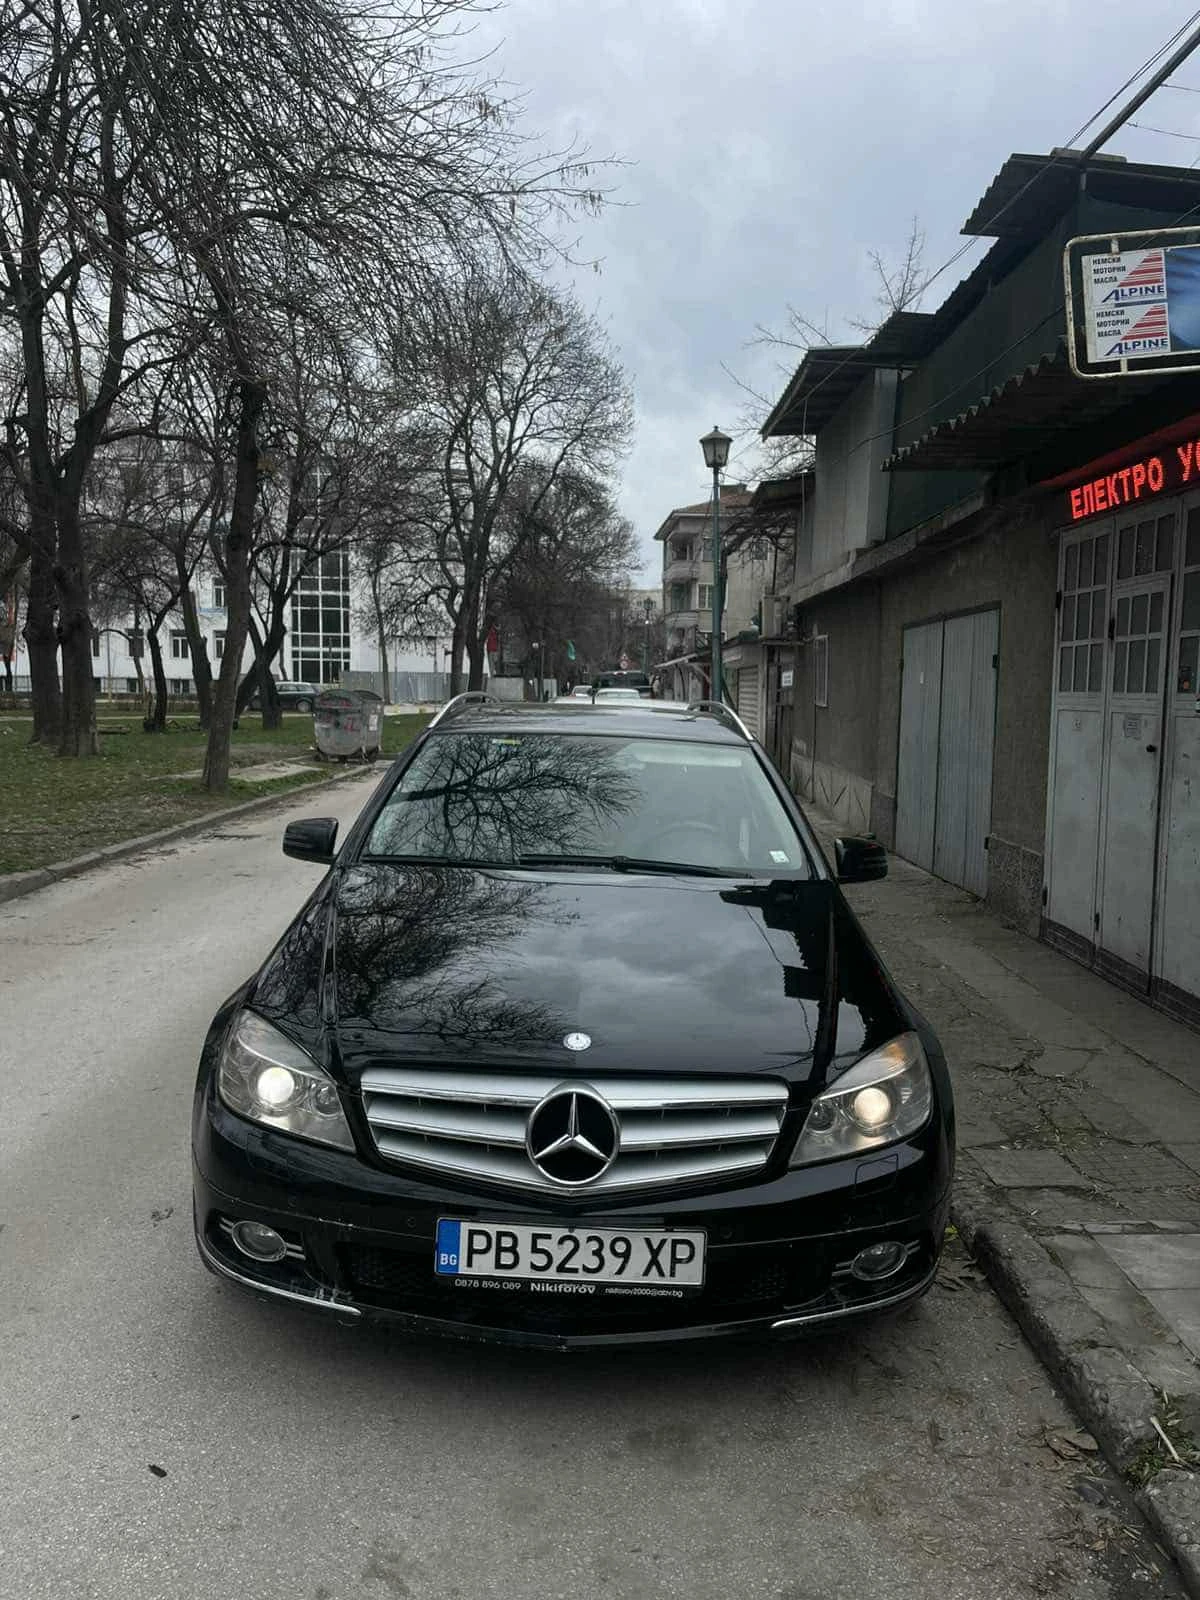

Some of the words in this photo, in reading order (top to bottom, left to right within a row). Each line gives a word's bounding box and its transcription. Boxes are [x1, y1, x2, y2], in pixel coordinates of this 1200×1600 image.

[1092, 256, 1121, 265] НЕМСКИ
[1093, 265, 1126, 275] МОТОРНИ
[1093, 276, 1118, 285] МАСЛА
[1101, 284, 1165, 303] ALPINE
[1096, 309, 1125, 318] НЕМСКИ
[1096, 318, 1130, 328] МОТОРНИ
[1097, 329, 1122, 338] МАСЛА
[1104, 337, 1168, 356] ALPINE
[1070, 457, 1163, 519] ЕЛЕКТРО
[465, 1228, 520, 1271] PB
[529, 1232, 633, 1276] 5239
[642, 1236, 696, 1278] XP
[440, 1253, 457, 1267] BG
[530, 1282, 596, 1294] Nikiforov
